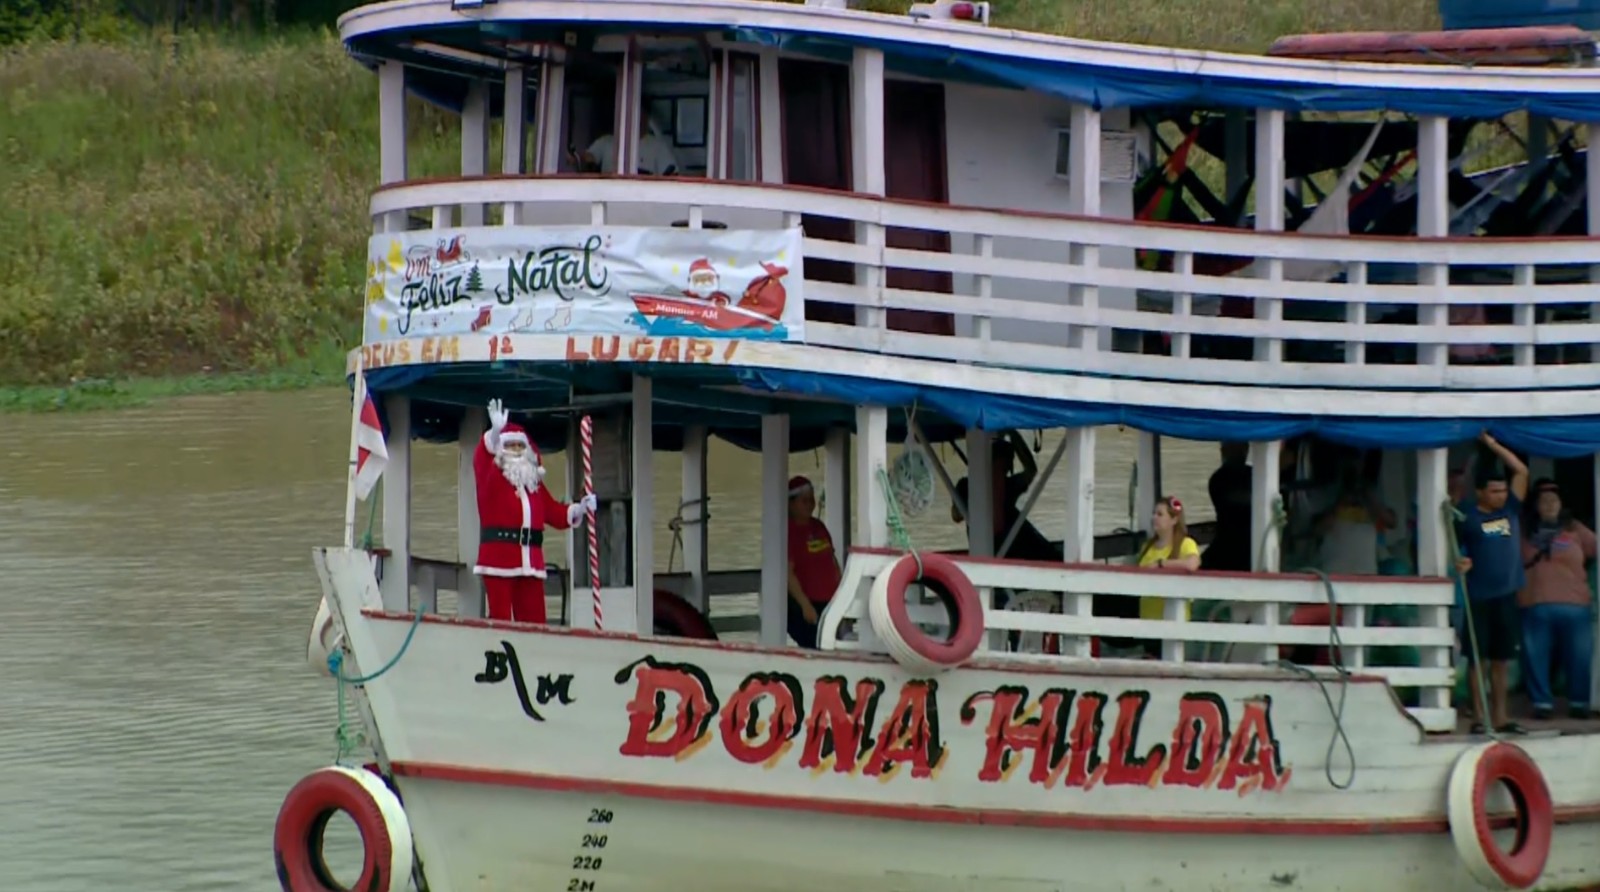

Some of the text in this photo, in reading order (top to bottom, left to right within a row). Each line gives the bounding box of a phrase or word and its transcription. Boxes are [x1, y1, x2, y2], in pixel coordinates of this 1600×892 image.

[397, 234, 611, 335] Feliz Natal
[701, 309, 719, 320] AM
[421, 336, 460, 363] EM
[614, 655, 949, 782] DONA
[960, 685, 1292, 797] HILDA
[587, 808, 613, 823] 260
[582, 833, 608, 849] 240
[573, 856, 602, 870] 220
